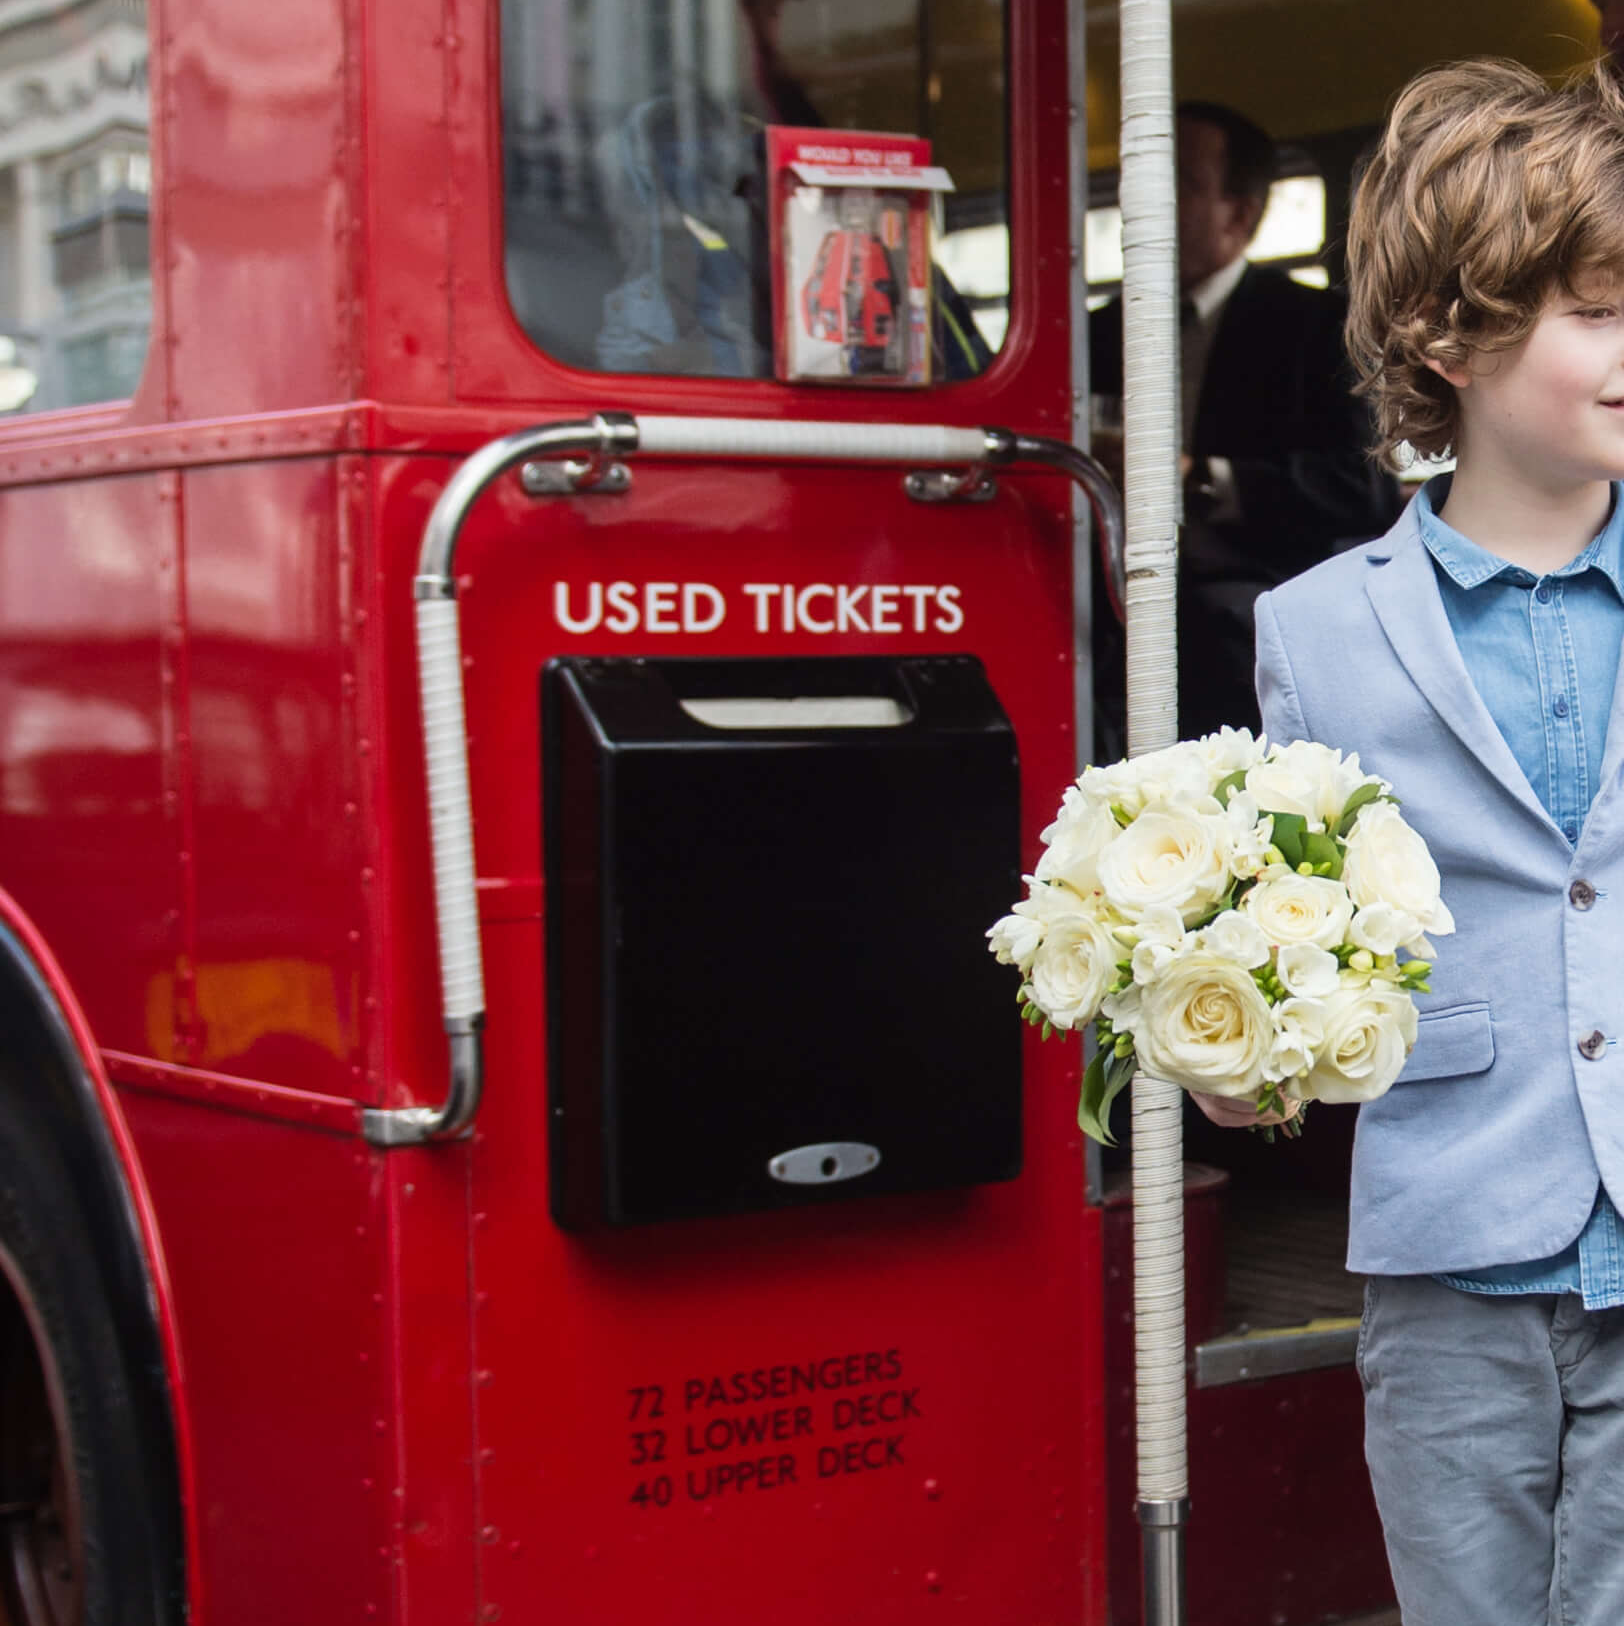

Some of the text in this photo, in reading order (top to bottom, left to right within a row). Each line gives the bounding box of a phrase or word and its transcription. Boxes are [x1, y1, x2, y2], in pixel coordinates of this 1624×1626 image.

[554, 581, 964, 634] USED TICKETS
[627, 1349, 903, 1421] 72 PASSENGERS
[630, 1388, 921, 1465] 32 LOWER DECK
[630, 1436, 904, 1509] 40 UPPER DECK
